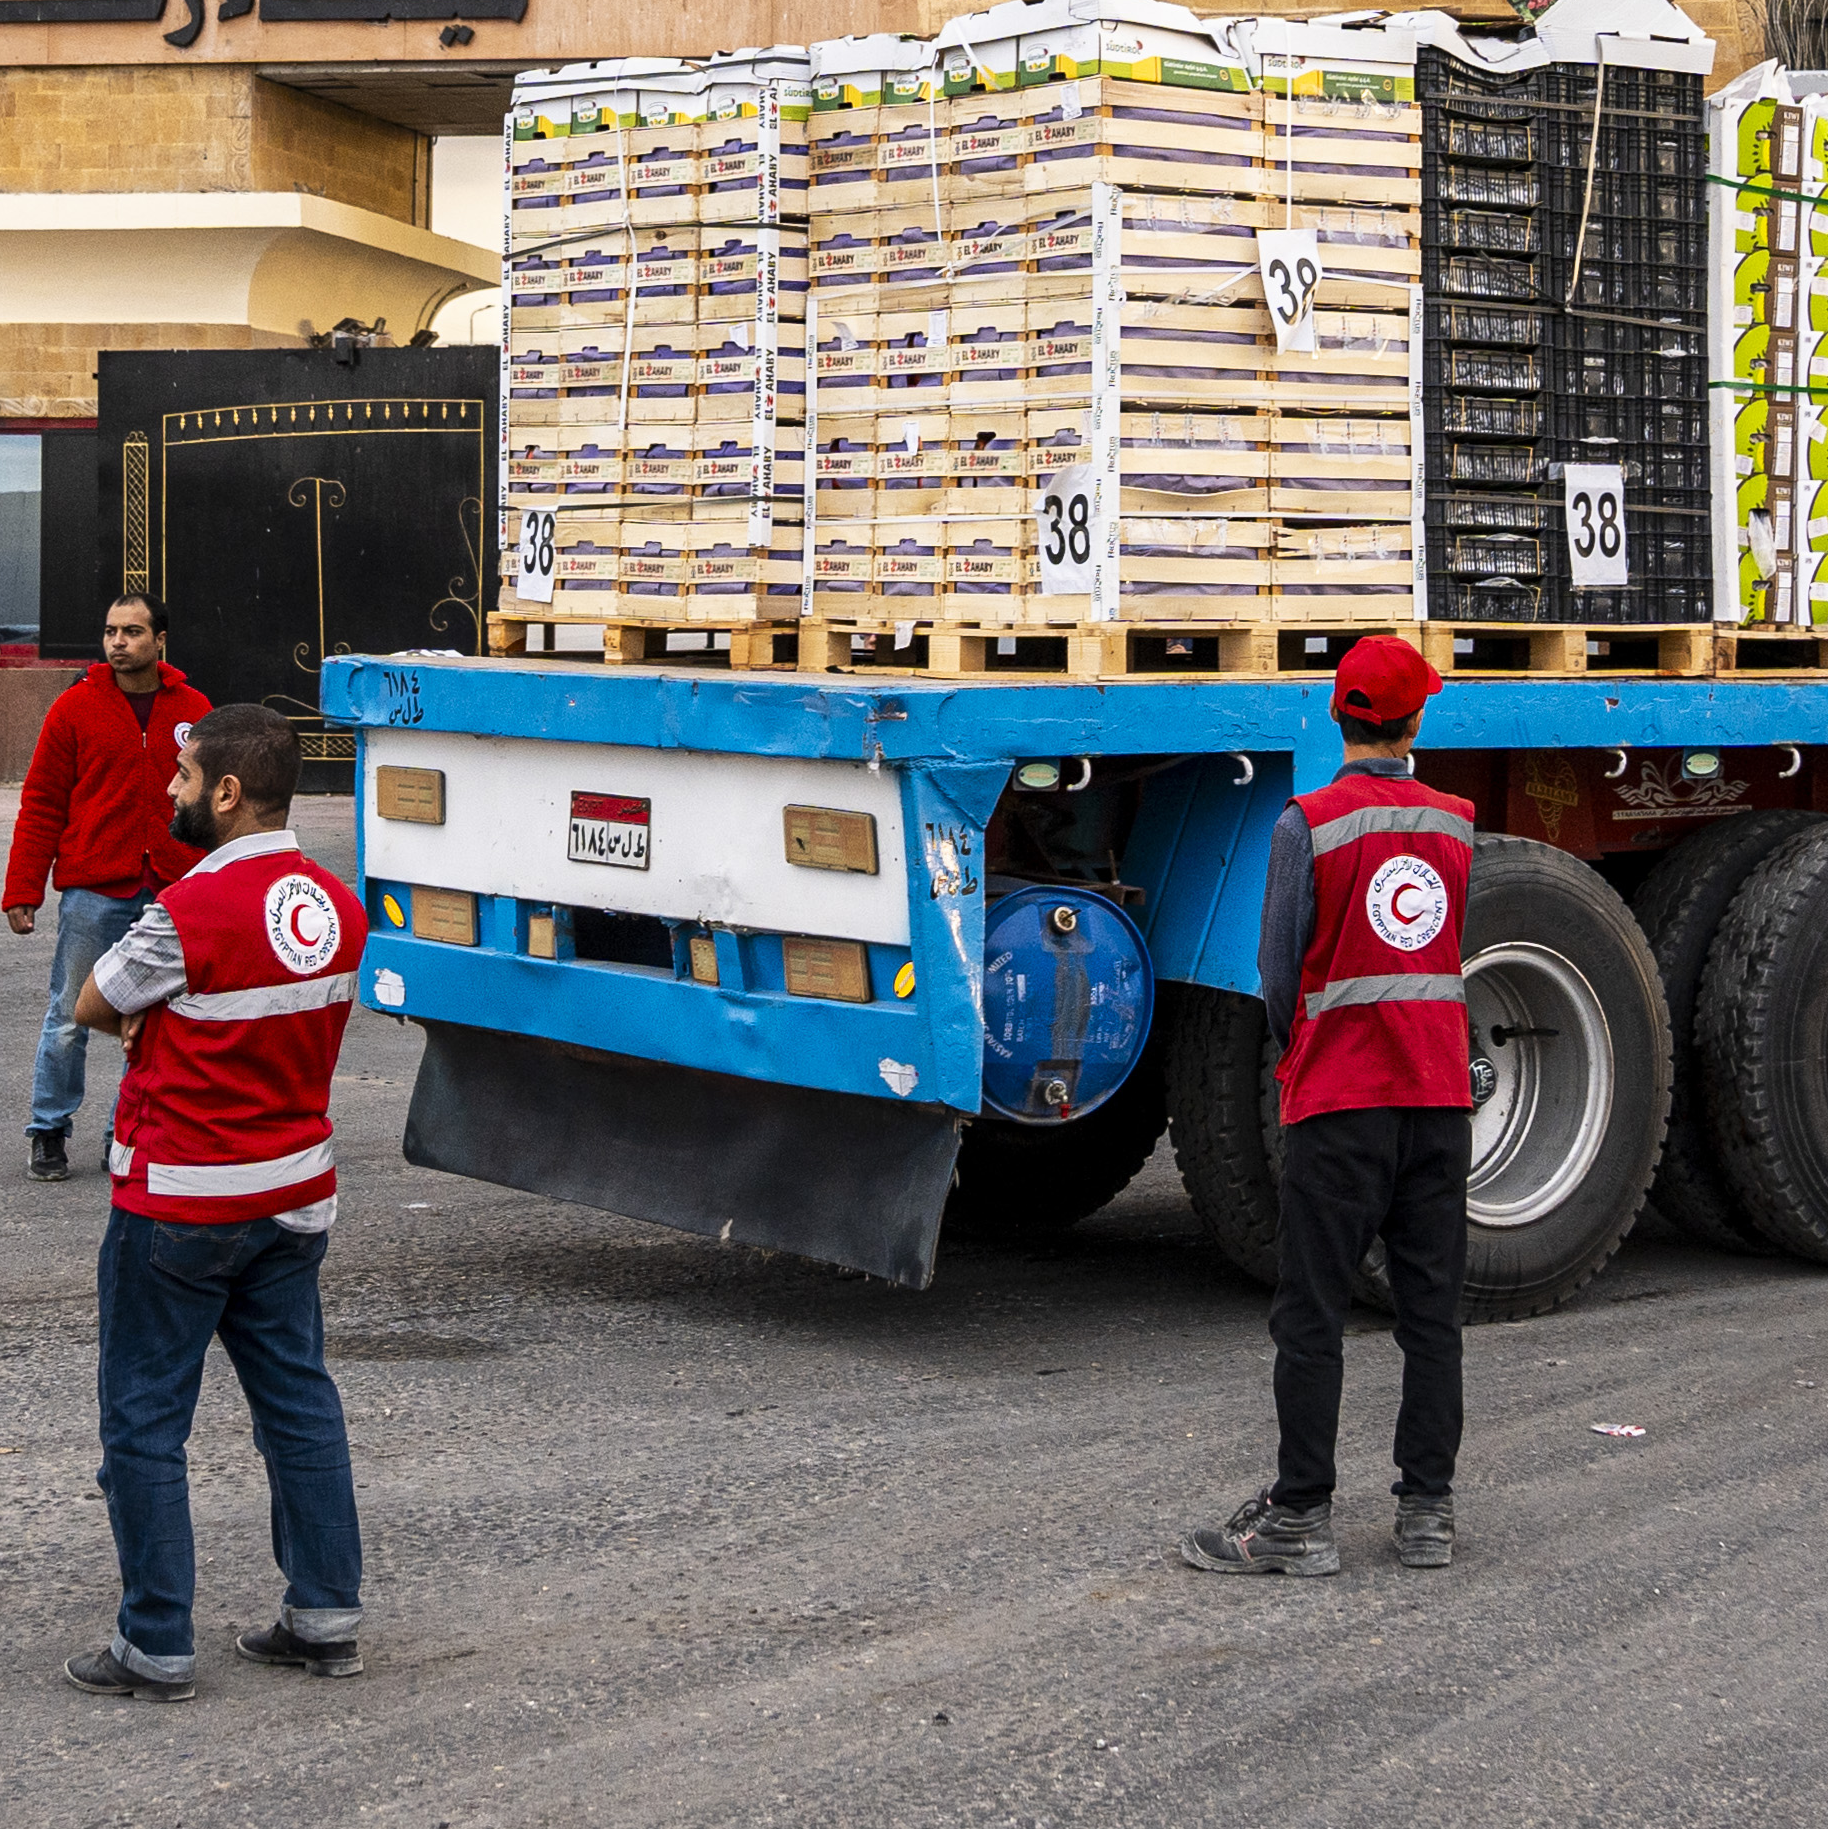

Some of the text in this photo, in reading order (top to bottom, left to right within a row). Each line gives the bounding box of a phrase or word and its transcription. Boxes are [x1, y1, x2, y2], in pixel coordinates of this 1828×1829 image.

[1784, 112, 1800, 121] KIWI
[1035, 125, 1075, 141] EL ZAHABY
[962, 135, 1000, 150] EL ZAHABY
[888, 149, 895, 158] EL
[711, 164, 717, 173] EL
[638, 170, 644, 179] EL
[504, 178, 511, 190] EL
[1038, 232, 1079, 249] EL ZAHABY
[819, 251, 854, 267] EL ZAHABY
[890, 251, 897, 261] EL
[570, 273, 576, 282] EL
[710, 269, 716, 278] EL
[1268, 257, 1318, 325] 38
[767, 310, 775, 323] EL
[962, 351, 969, 360] EL
[1038, 346, 1045, 355] EL
[503, 359, 509, 370] EL
[817, 358, 825, 367] EL
[889, 356, 896, 365] EL
[639, 369, 645, 377] EL
[706, 366, 713, 374] EL
[765, 407, 773, 421] EL
[501, 449, 508, 461] EL
[1036, 455, 1043, 465] EL
[817, 460, 823, 469] EL
[960, 457, 967, 467] EL
[566, 466, 572, 474] EL
[703, 466, 710, 475] EL
[1043, 493, 1090, 565] 38
[1572, 491, 1621, 558] 38
[524, 511, 555, 576] 38
[698, 565, 704, 573] EL
[956, 564, 962, 573] EL
[383, 670, 420, 698] ٦١٨٤
[573, 823, 606, 857] ٦١٨٤
[1373, 903, 1397, 942] EGYPTIAN
[1417, 900, 1442, 944] CRESCENT
